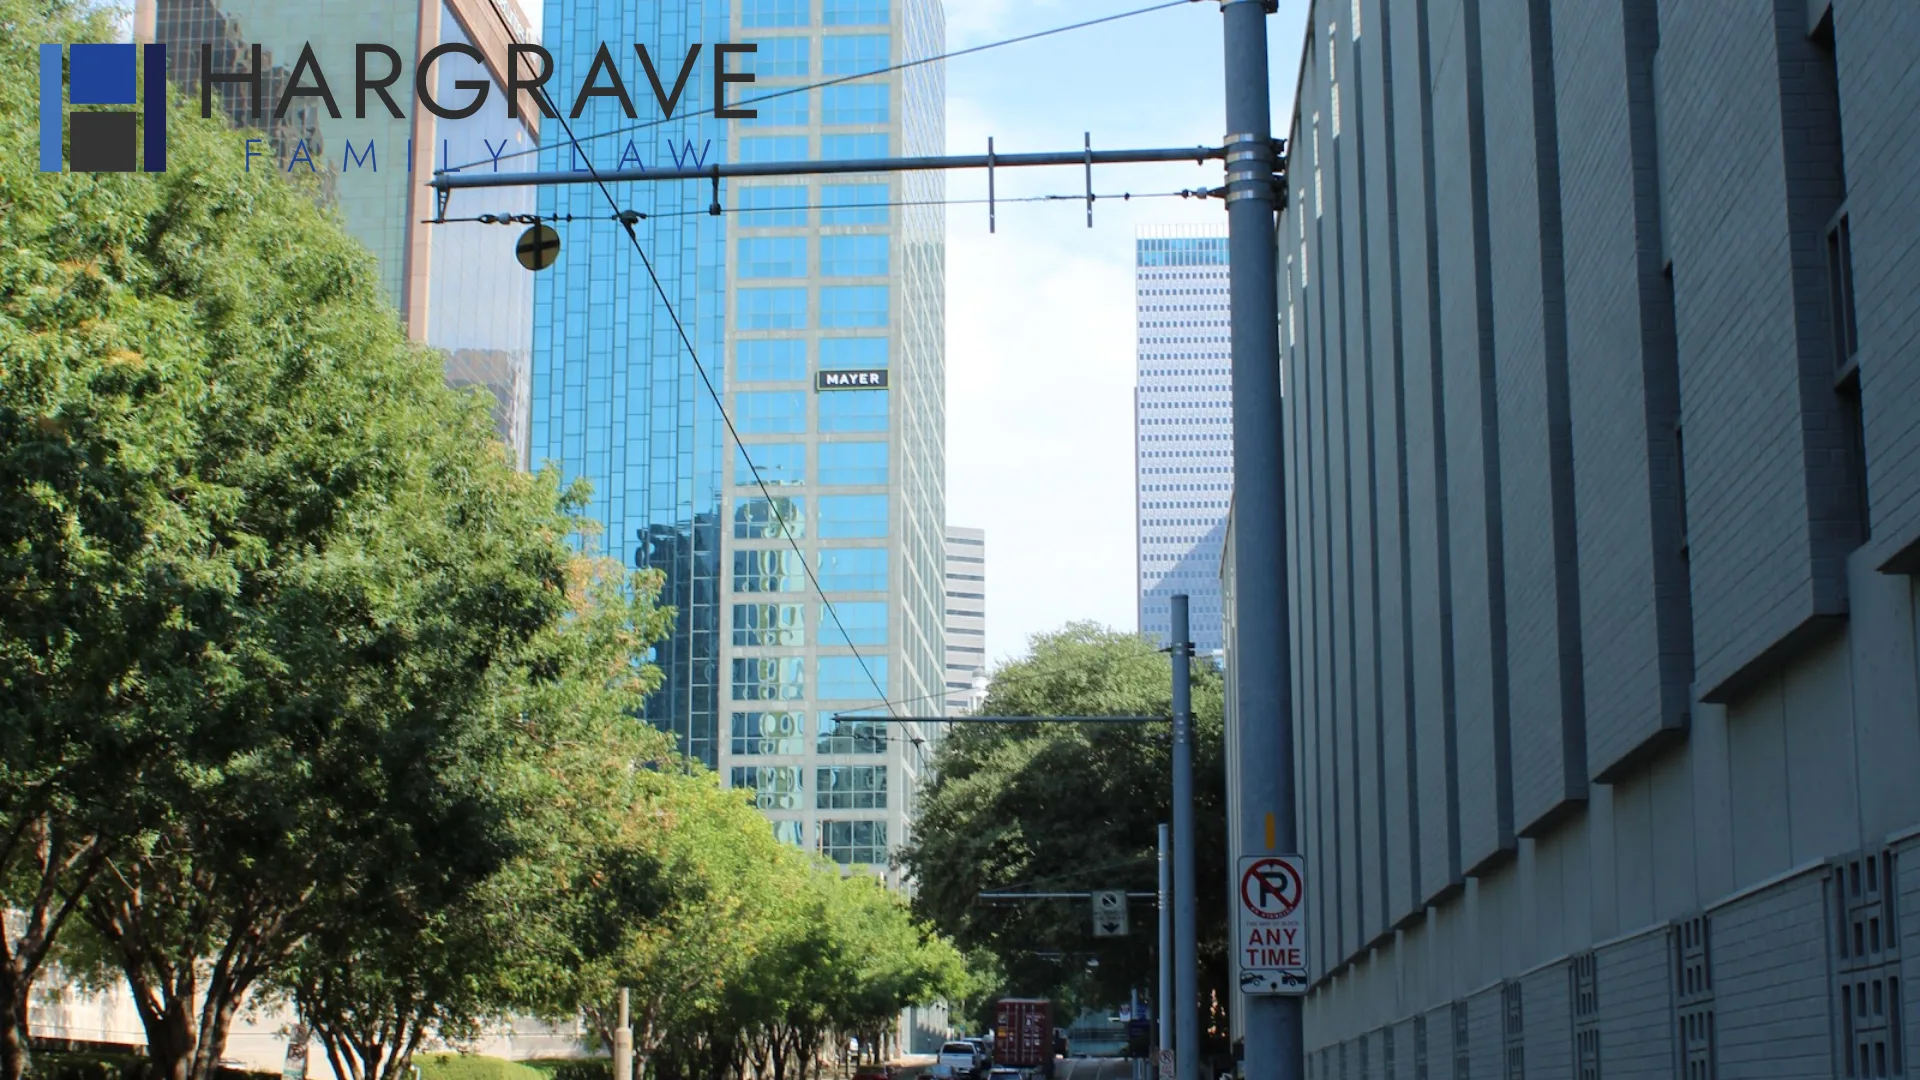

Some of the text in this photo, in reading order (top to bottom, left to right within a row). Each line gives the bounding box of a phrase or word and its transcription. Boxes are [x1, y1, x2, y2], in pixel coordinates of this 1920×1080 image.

[826, 372, 880, 385] MAYER
[1249, 928, 1297, 946] ANY
[1246, 949, 1301, 966] TIME
